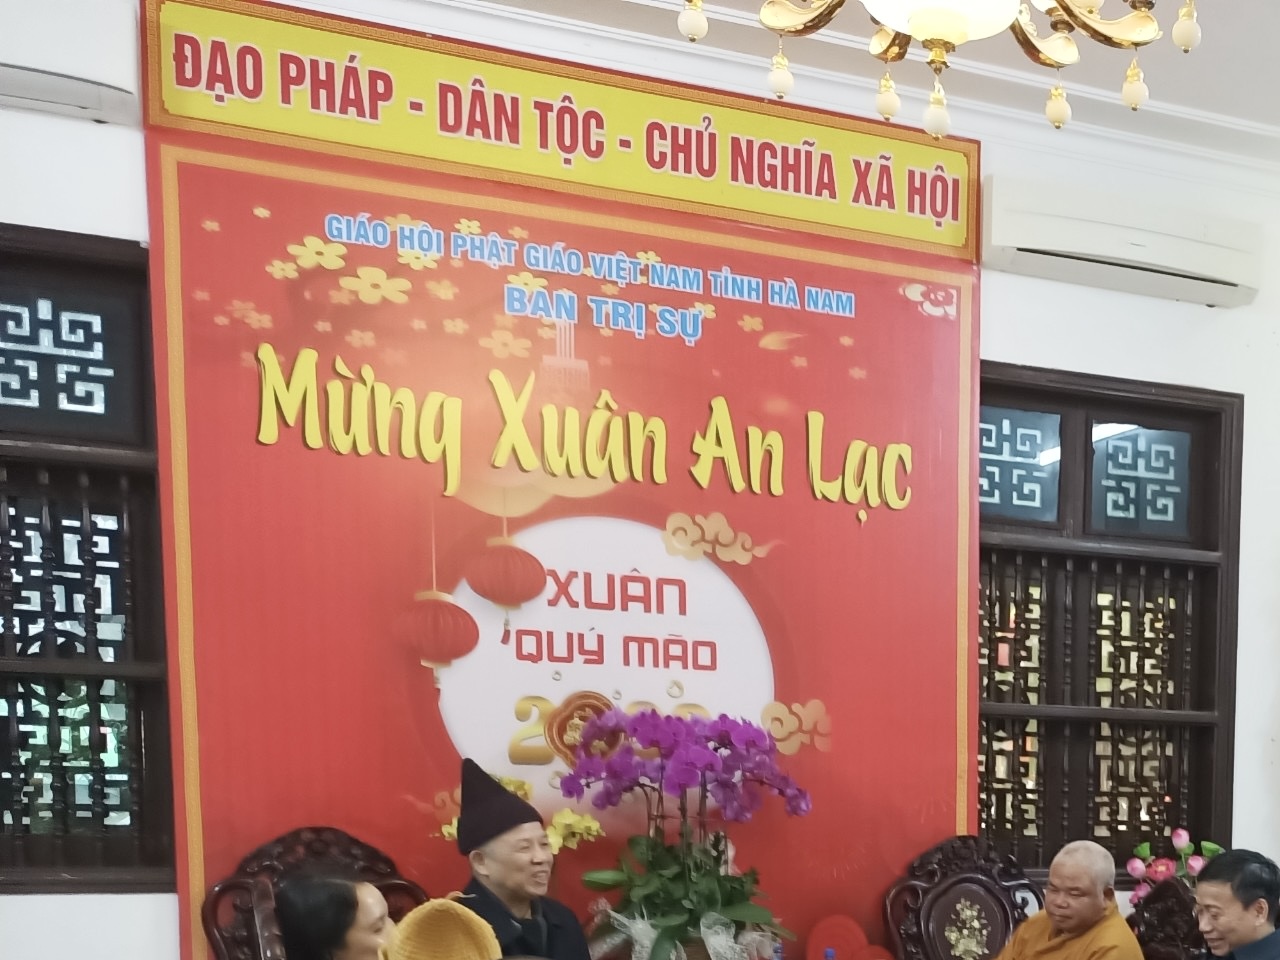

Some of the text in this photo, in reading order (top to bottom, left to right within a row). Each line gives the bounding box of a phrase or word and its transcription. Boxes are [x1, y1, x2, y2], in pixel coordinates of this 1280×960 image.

[173, 33, 263, 103] ĐẠO
[279, 54, 394, 121] PHÁP
[438, 78, 520, 145] DÂN
[533, 95, 605, 165] TỘC
[646, 116, 717, 178] CHỦ
[730, 140, 837, 200] NGHĨA
[852, 155, 895, 210] XÃ
[907, 165, 959, 227] HỘI
[326, 213, 855, 318] GIÁO HỘI PHẬT GIÁO VIỆT NAM TỈNH HÀ NAM
[504, 284, 704, 346] BAN TRỊ SỰ
[256, 342, 912, 526] Mừng Xuân An Lạc
[546, 568, 687, 617] XUÂN
[515, 627, 717, 671] QUÝ MÃO
